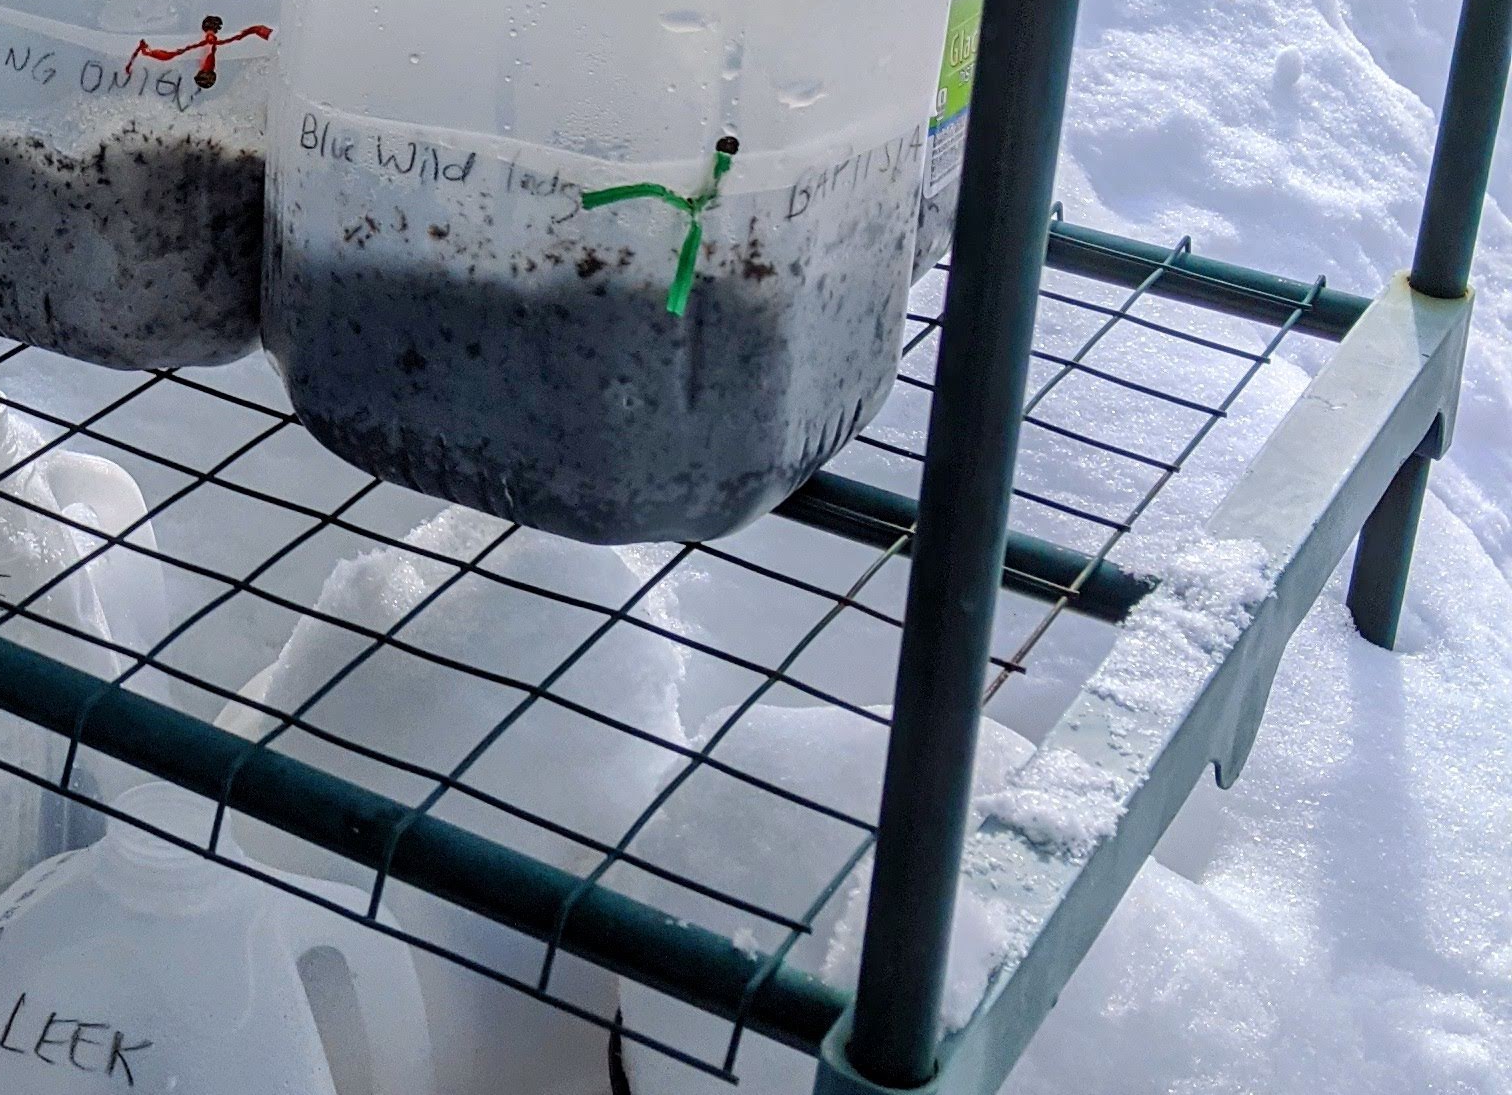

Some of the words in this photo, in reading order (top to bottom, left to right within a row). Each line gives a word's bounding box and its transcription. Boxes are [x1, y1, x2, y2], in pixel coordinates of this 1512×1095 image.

[300, 112, 355, 163] Blue
[376, 135, 477, 185] Wild
[0, 992, 154, 1087] LEEK
